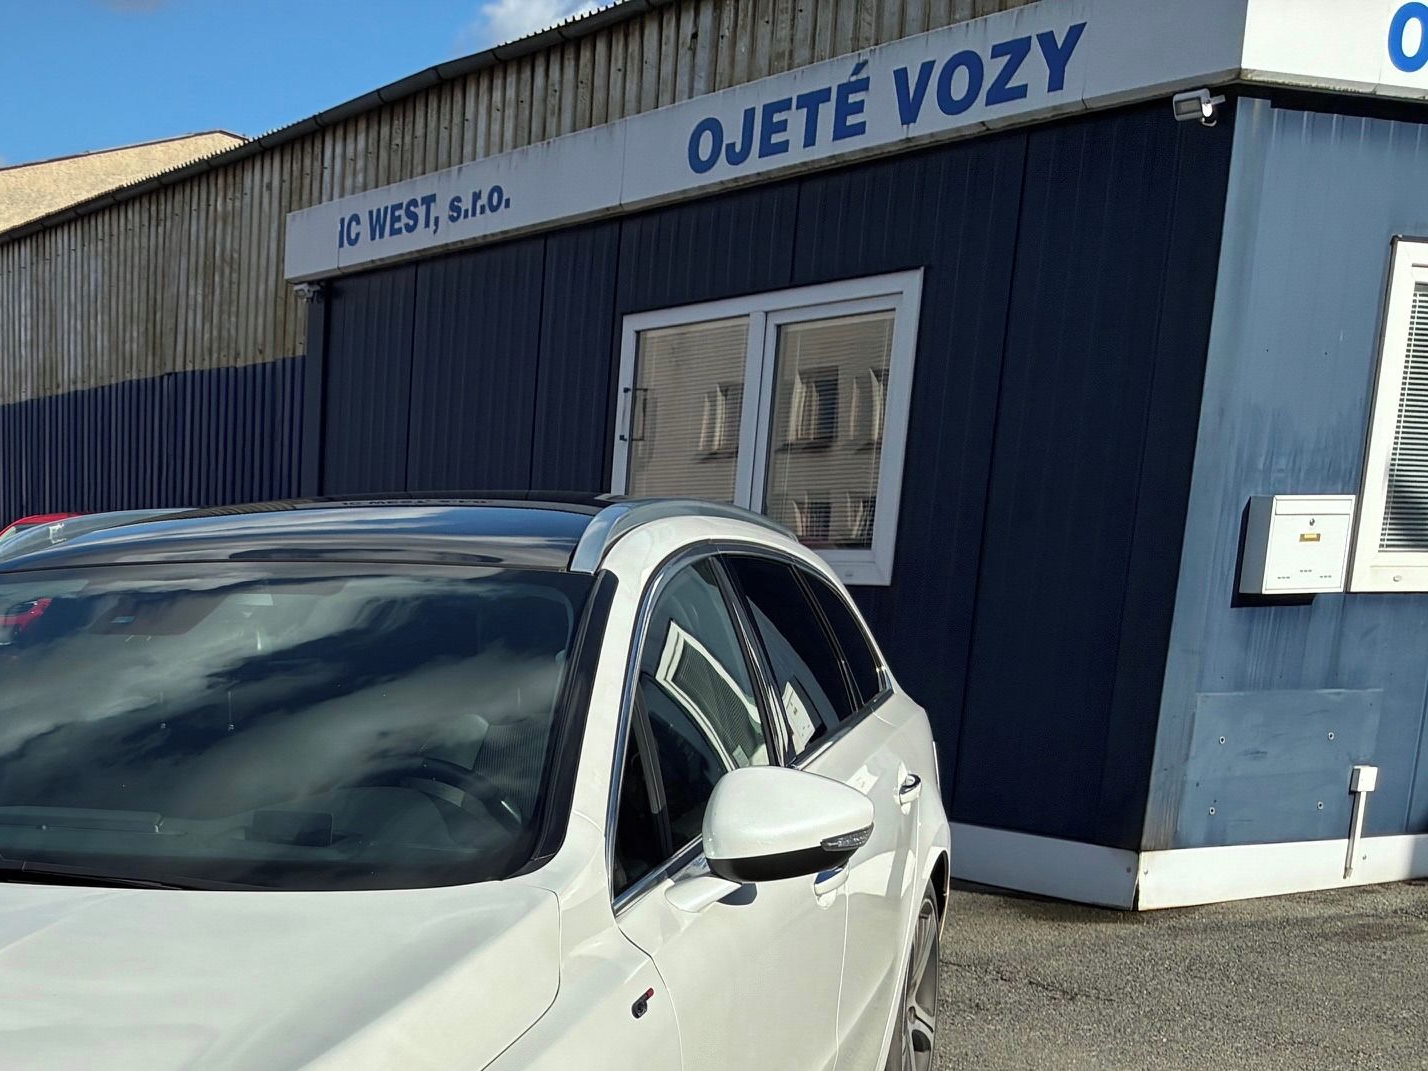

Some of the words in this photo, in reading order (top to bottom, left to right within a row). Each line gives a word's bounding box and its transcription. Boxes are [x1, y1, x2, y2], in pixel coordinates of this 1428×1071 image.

[687, 59, 871, 175] OJETÉ
[892, 21, 1088, 127] VOZY
[338, 212, 362, 249] IC
[368, 193, 440, 236] WEST,
[448, 184, 511, 224] s.r.o.
